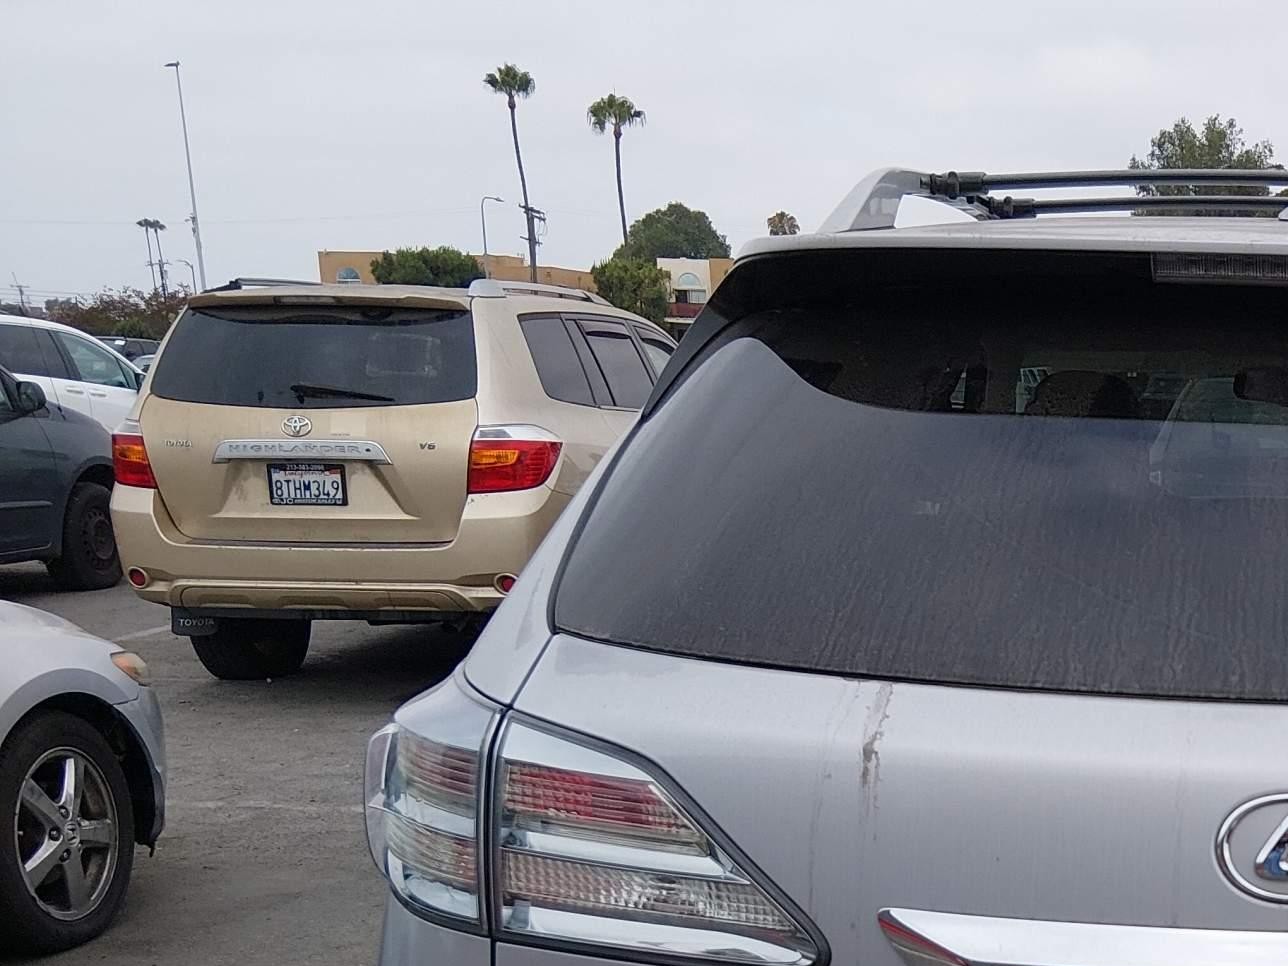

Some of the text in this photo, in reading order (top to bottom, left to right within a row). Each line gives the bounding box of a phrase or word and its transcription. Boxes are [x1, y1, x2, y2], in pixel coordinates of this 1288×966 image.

[228, 443, 362, 453] HIGHLANDER
[419, 442, 437, 450] V6
[274, 479, 340, 498] 8THM349
[179, 618, 215, 626] TOYOTA
